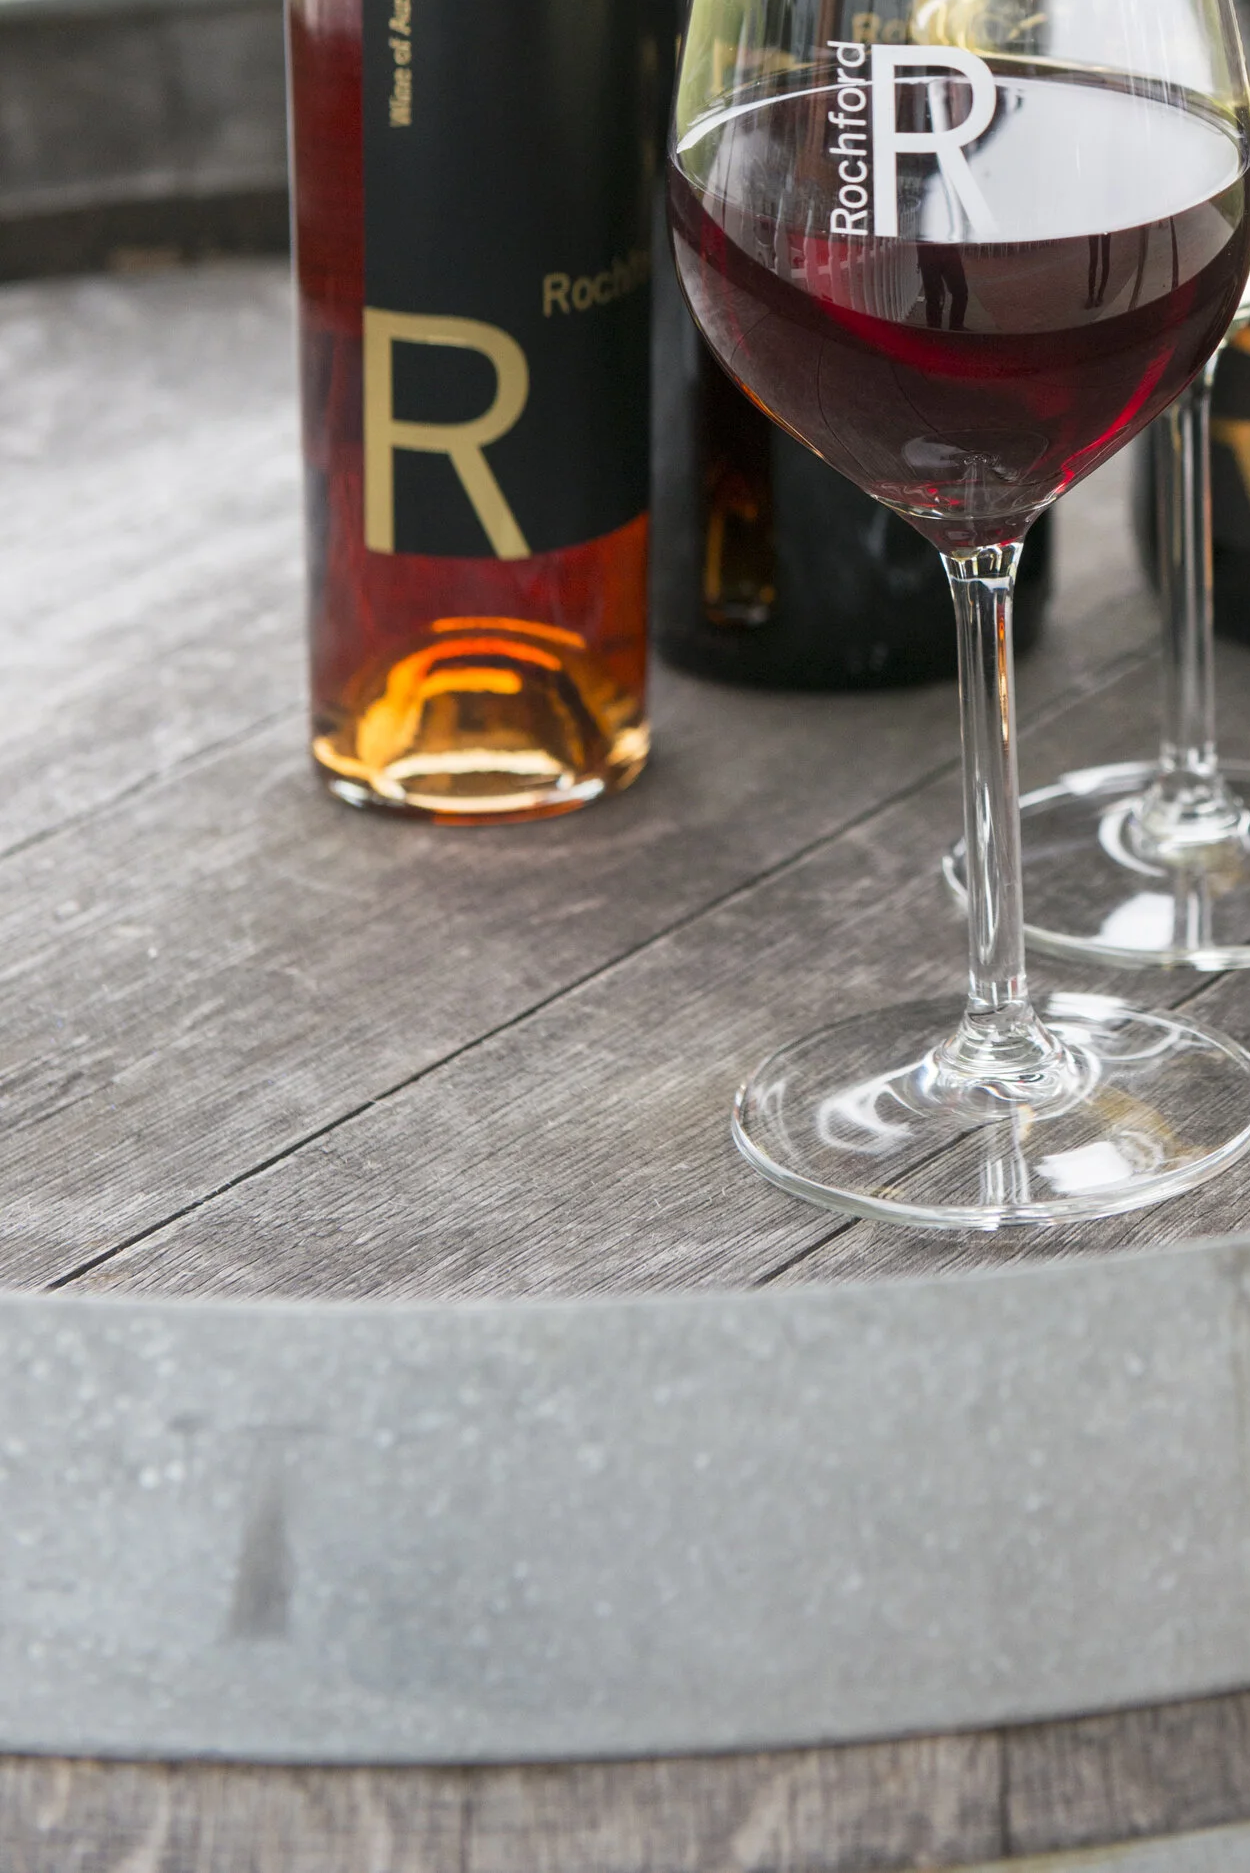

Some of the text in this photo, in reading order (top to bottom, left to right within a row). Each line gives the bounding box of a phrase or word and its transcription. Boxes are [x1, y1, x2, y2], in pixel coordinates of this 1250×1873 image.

[388, 36, 411, 65] of
[389, 67, 412, 127] Wine
[827, 41, 868, 236] Rochford
[871, 44, 1000, 237] R
[362, 306, 532, 561] R
